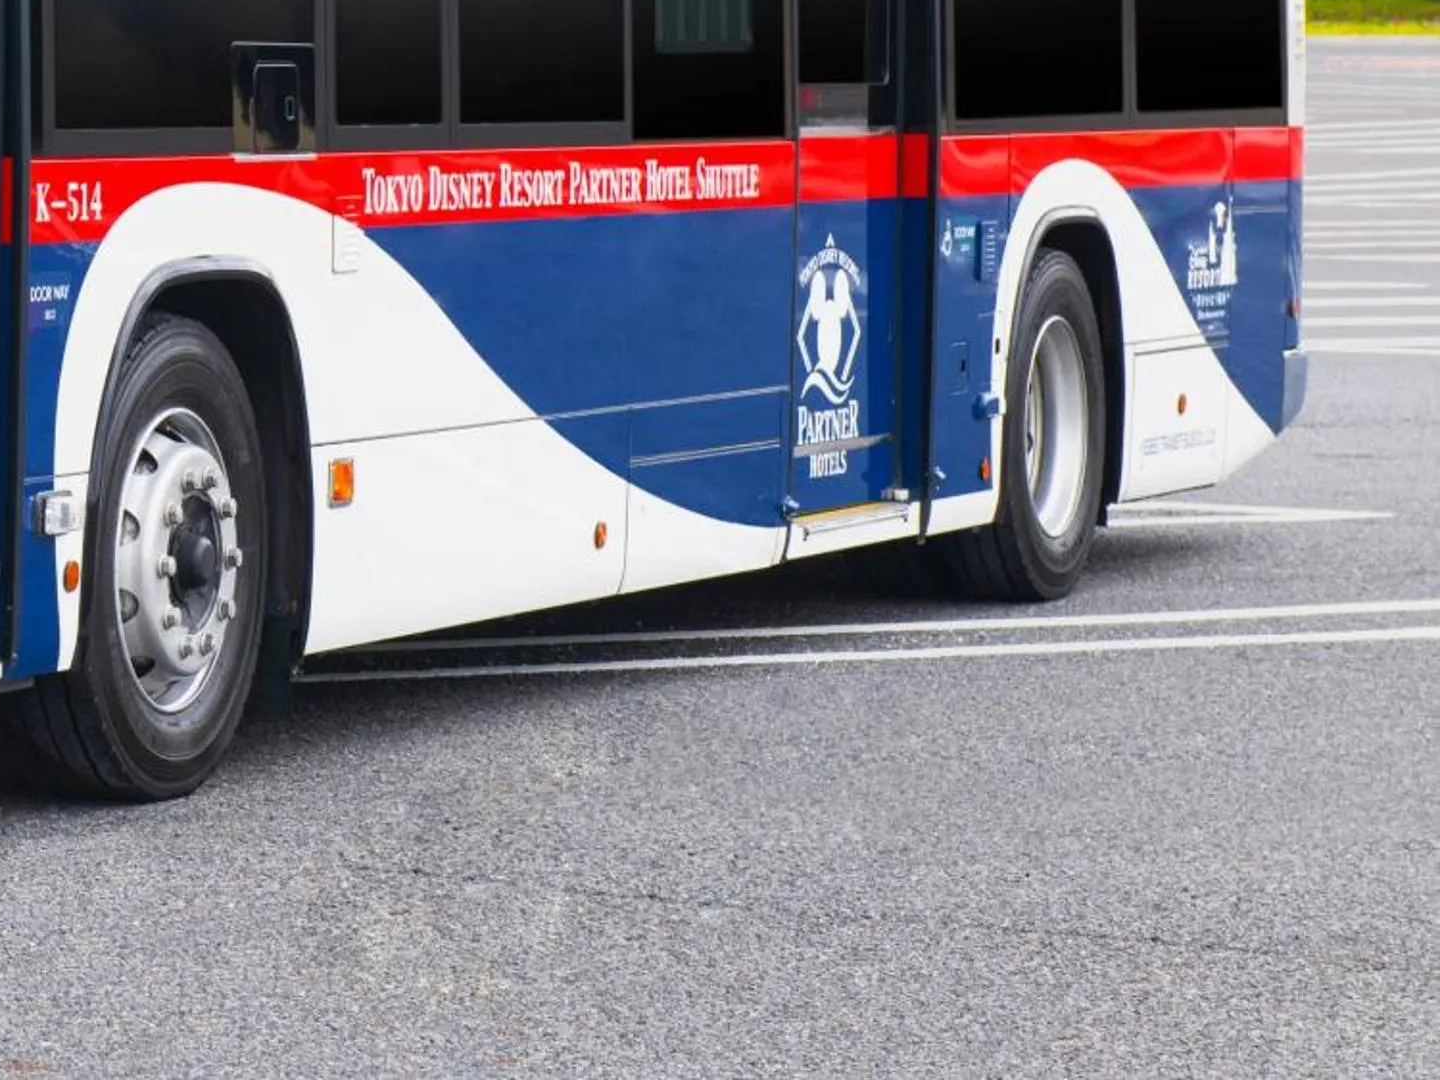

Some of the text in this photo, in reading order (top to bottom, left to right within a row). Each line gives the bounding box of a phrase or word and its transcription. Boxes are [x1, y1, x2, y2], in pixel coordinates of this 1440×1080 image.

[35, 181, 103, 223] K-514
[797, 399, 859, 445] PARTNER
[809, 450, 848, 479] HOTELS
